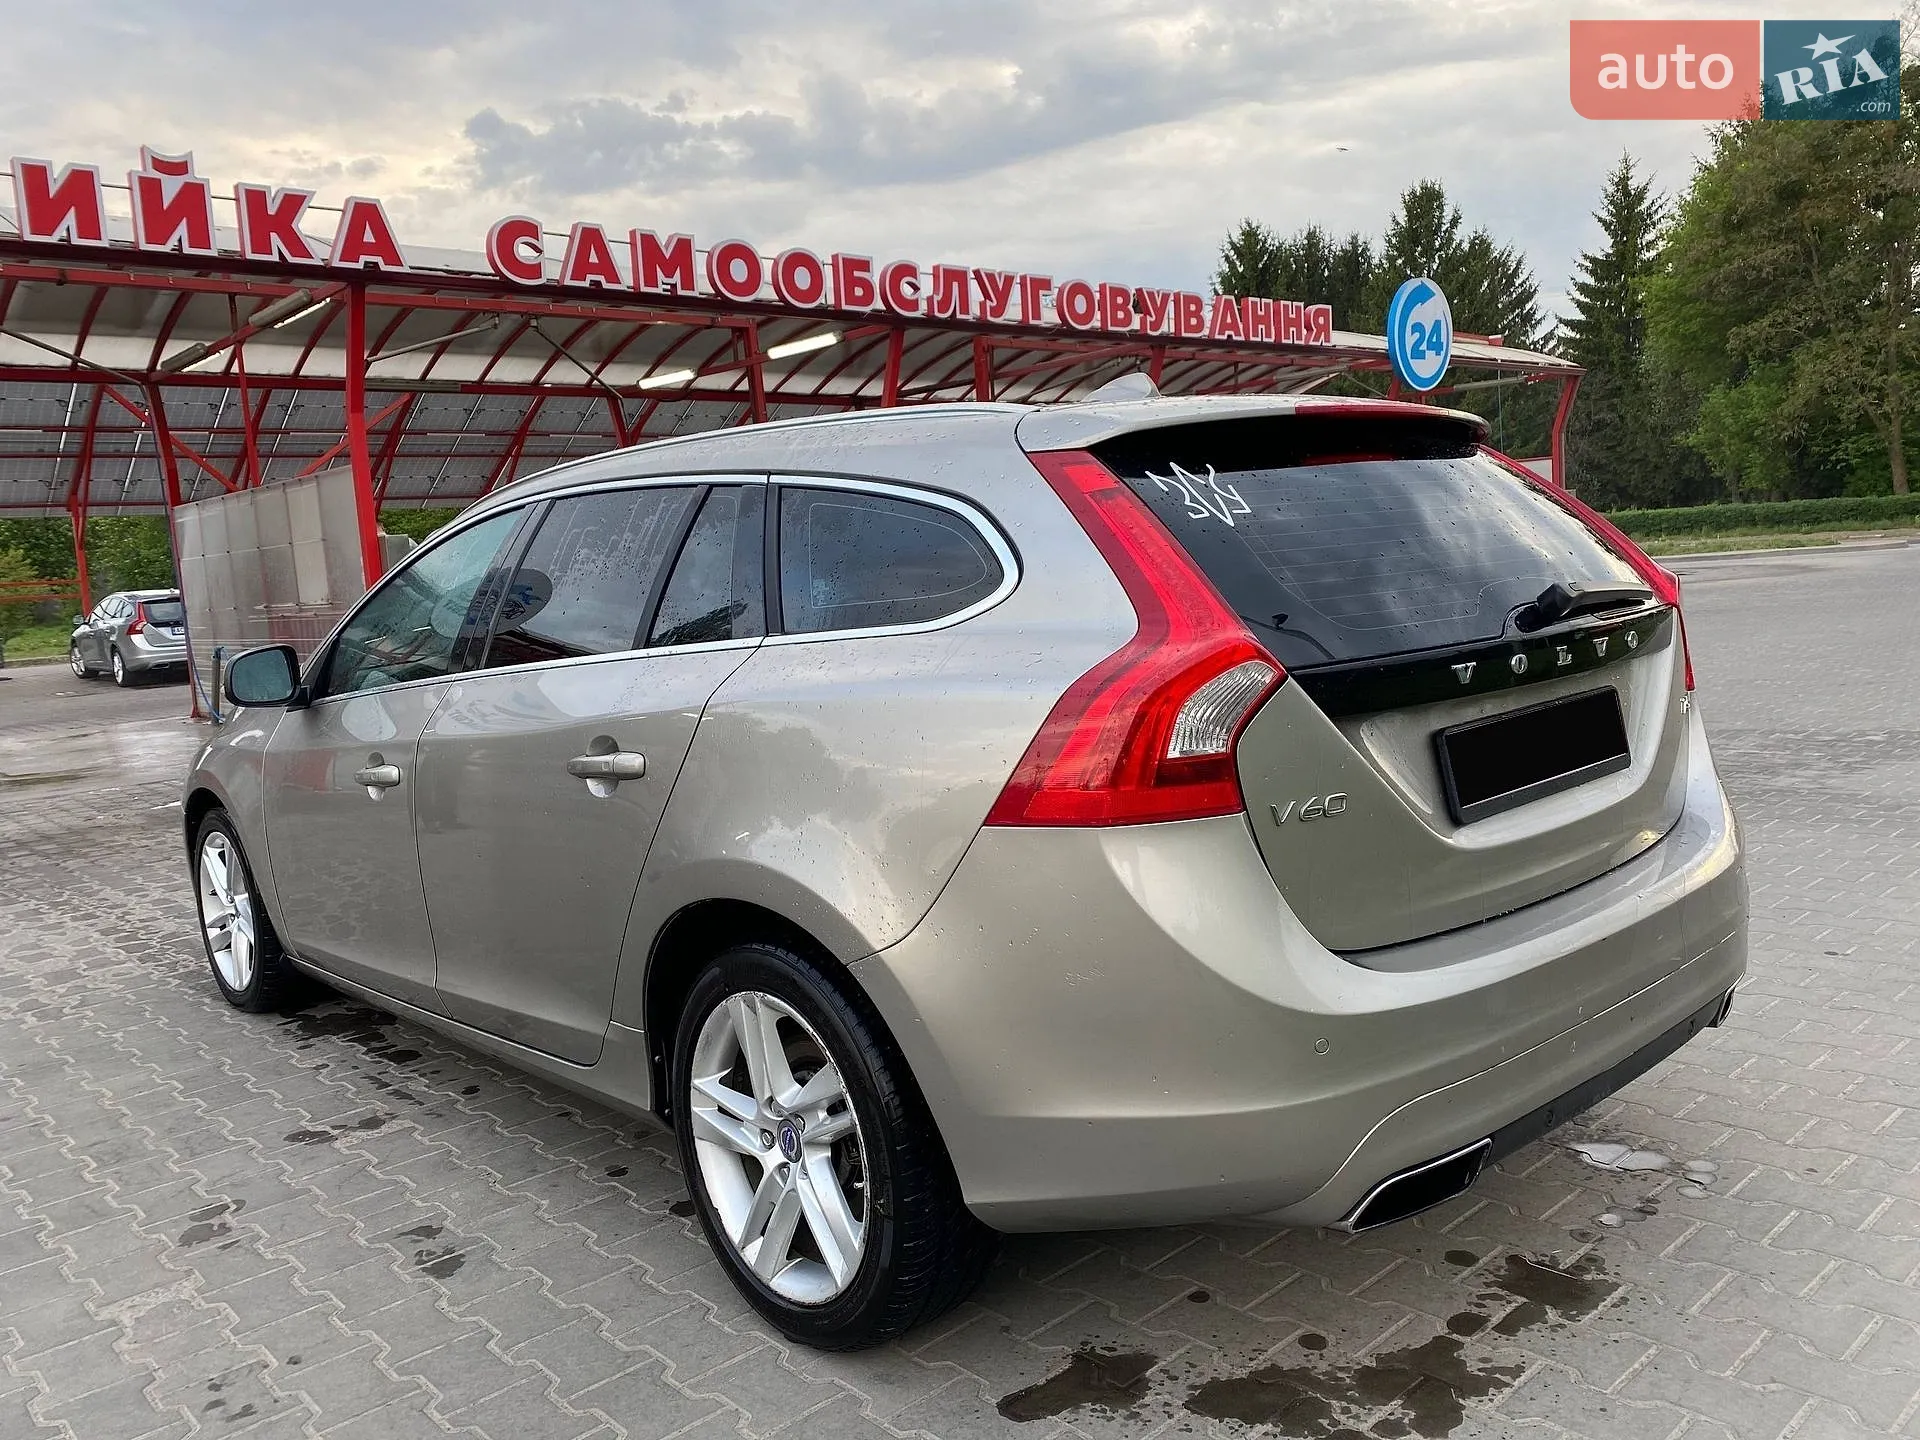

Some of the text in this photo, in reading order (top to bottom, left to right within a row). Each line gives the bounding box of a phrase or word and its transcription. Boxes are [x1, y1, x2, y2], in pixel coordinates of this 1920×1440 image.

[486, 215, 1333, 348] САМООБСЛУГОВУВАННЯ
[1411, 320, 1444, 360] 24
[1450, 630, 1640, 685] VOLVO
[1270, 792, 1348, 826] V60
